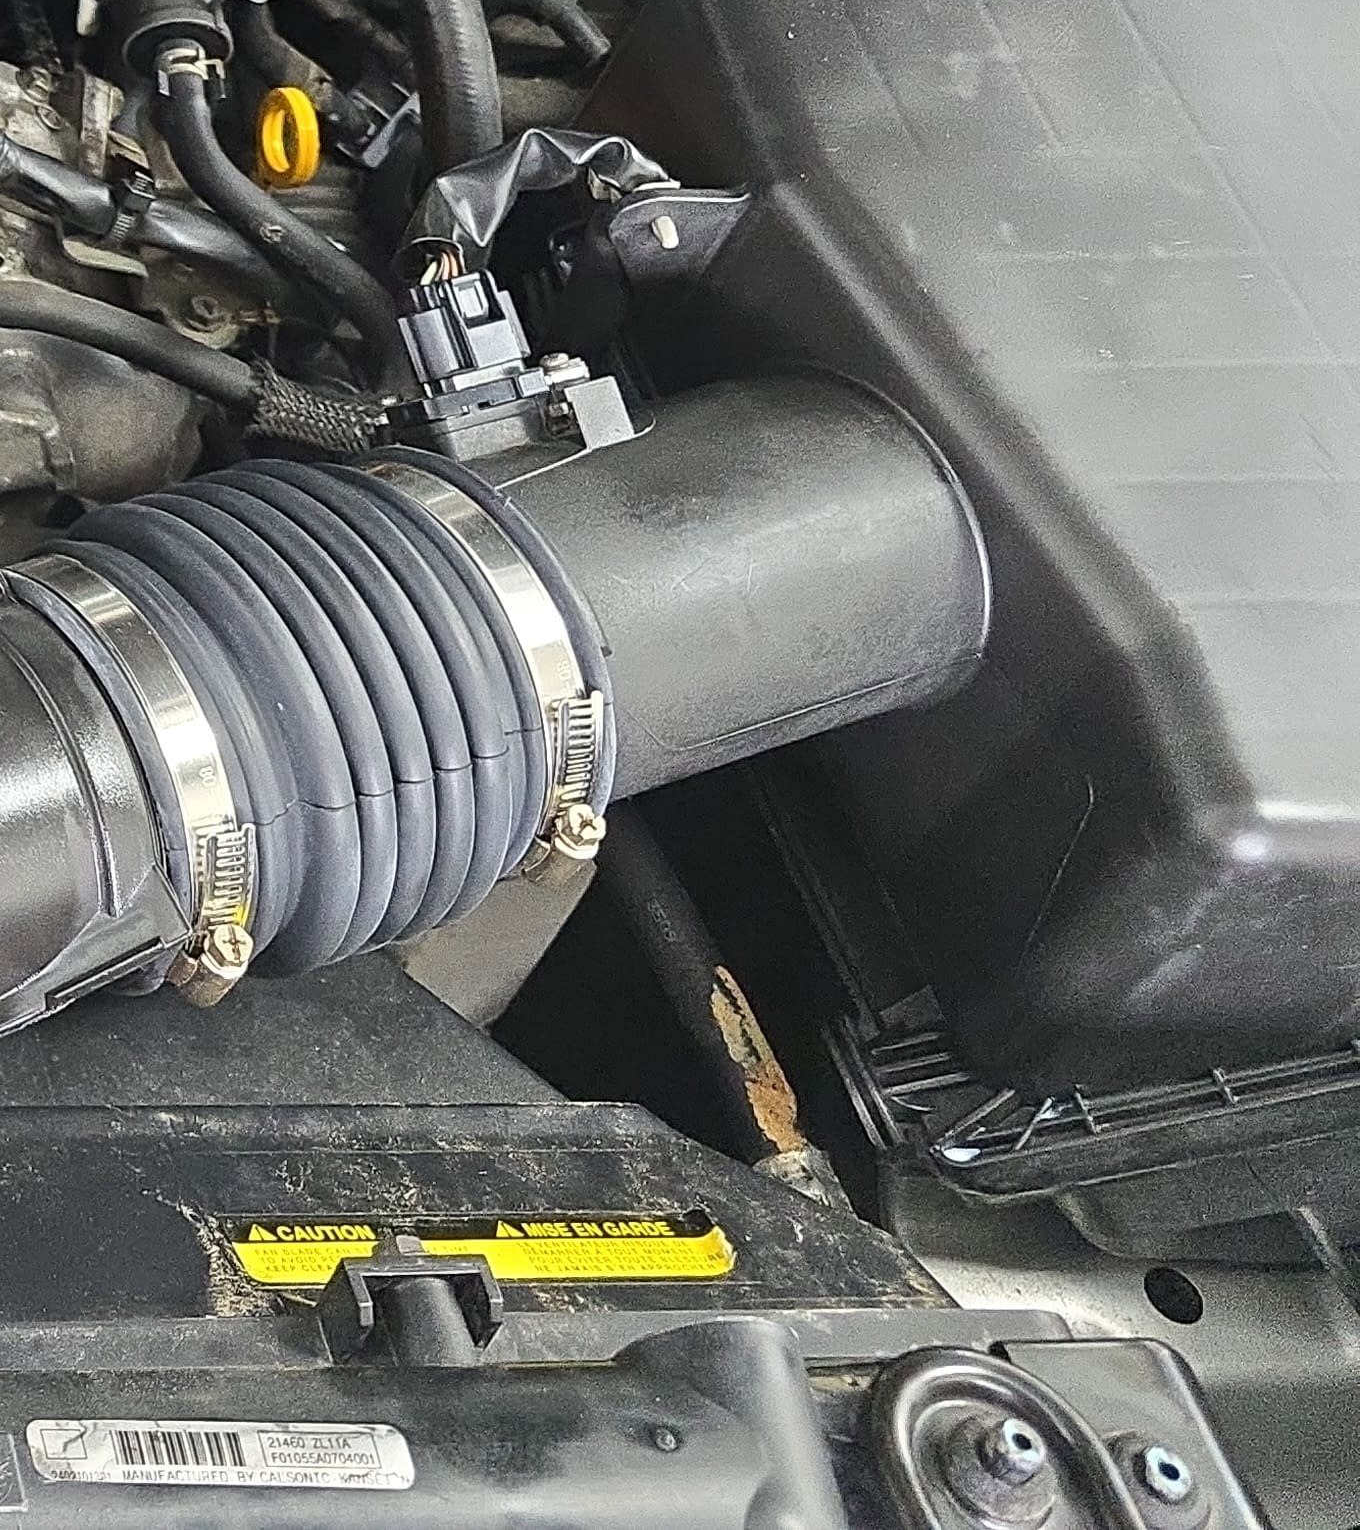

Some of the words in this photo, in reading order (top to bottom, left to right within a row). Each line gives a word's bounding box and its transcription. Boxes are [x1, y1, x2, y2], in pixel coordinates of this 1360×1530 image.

[276, 1225, 376, 1240] CAUTION
[521, 1222, 572, 1238] MISE
[571, 1223, 603, 1237] EN
[603, 1221, 675, 1237] GARDE
[267, 1437, 305, 1449] 21460
[122, 1471, 228, 1483] MANUFACTURED
[237, 1472, 253, 1482] BY
[260, 1472, 329, 1483] CALSONIC
